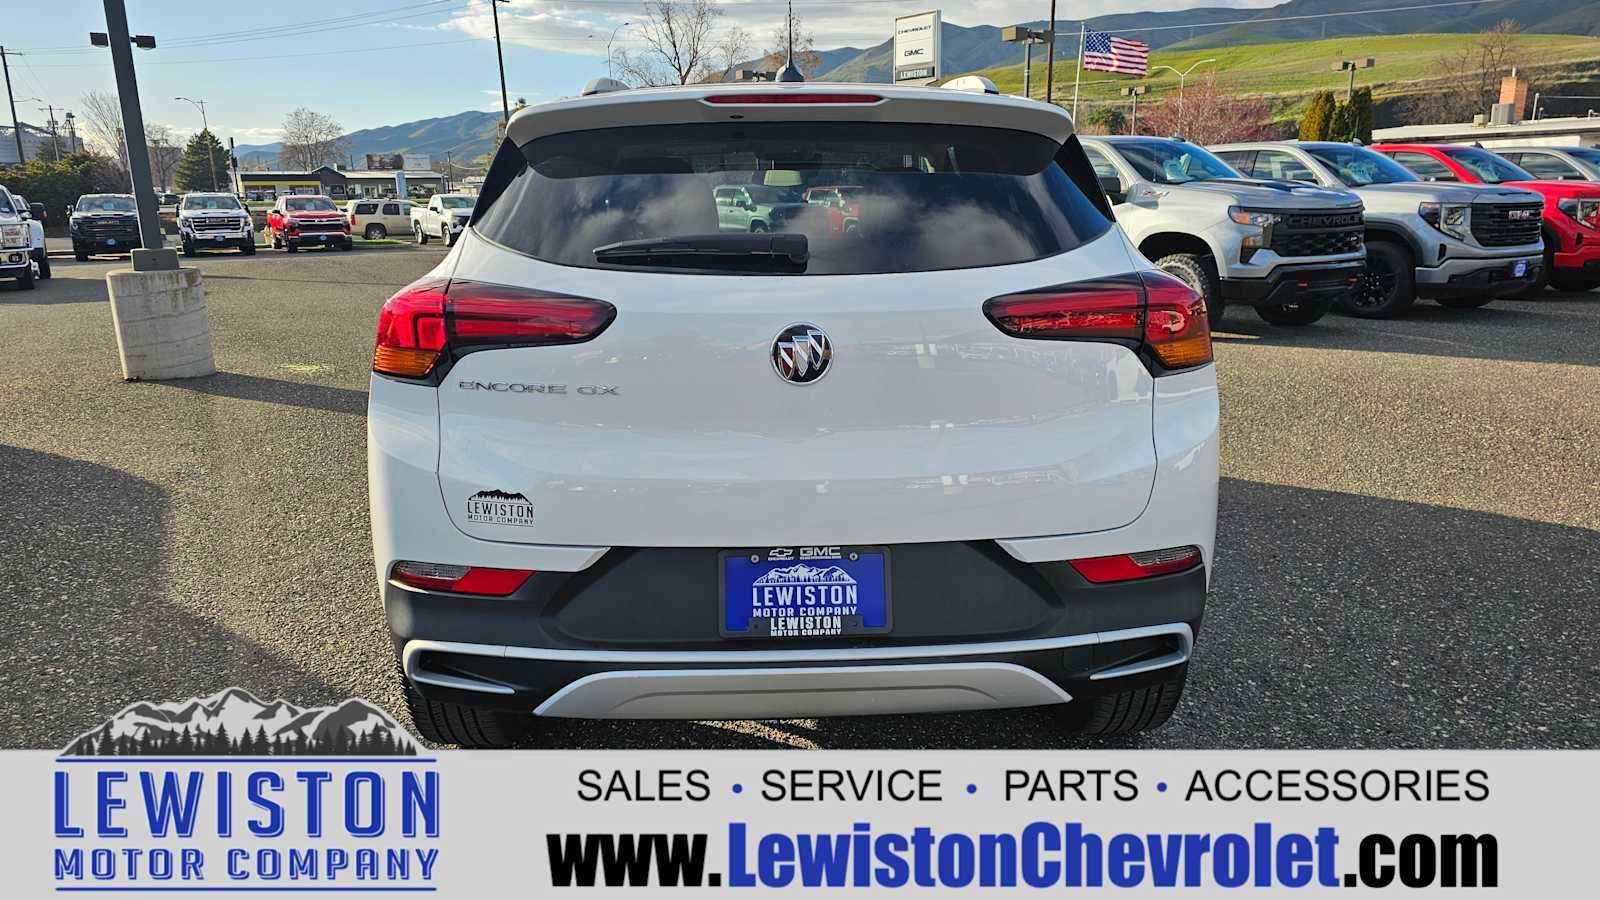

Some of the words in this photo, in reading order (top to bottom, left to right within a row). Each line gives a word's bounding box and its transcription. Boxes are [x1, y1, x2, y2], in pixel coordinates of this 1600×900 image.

[904, 48, 924, 57] GMC
[900, 69, 928, 79] LEWISTON
[1288, 215, 1362, 226] CHEVROLE
[459, 381, 568, 394] ENCORE
[576, 385, 622, 396] GX
[467, 501, 534, 518] LEWISTON
[467, 514, 493, 522] MOTOR
[496, 516, 534, 525] COMPANY
[799, 546, 841, 556] GMC
[753, 585, 857, 606] LEWISTON
[752, 607, 795, 617] MOTOR
[800, 606, 857, 616] COMPANY
[770, 616, 841, 629] LEWISTON
